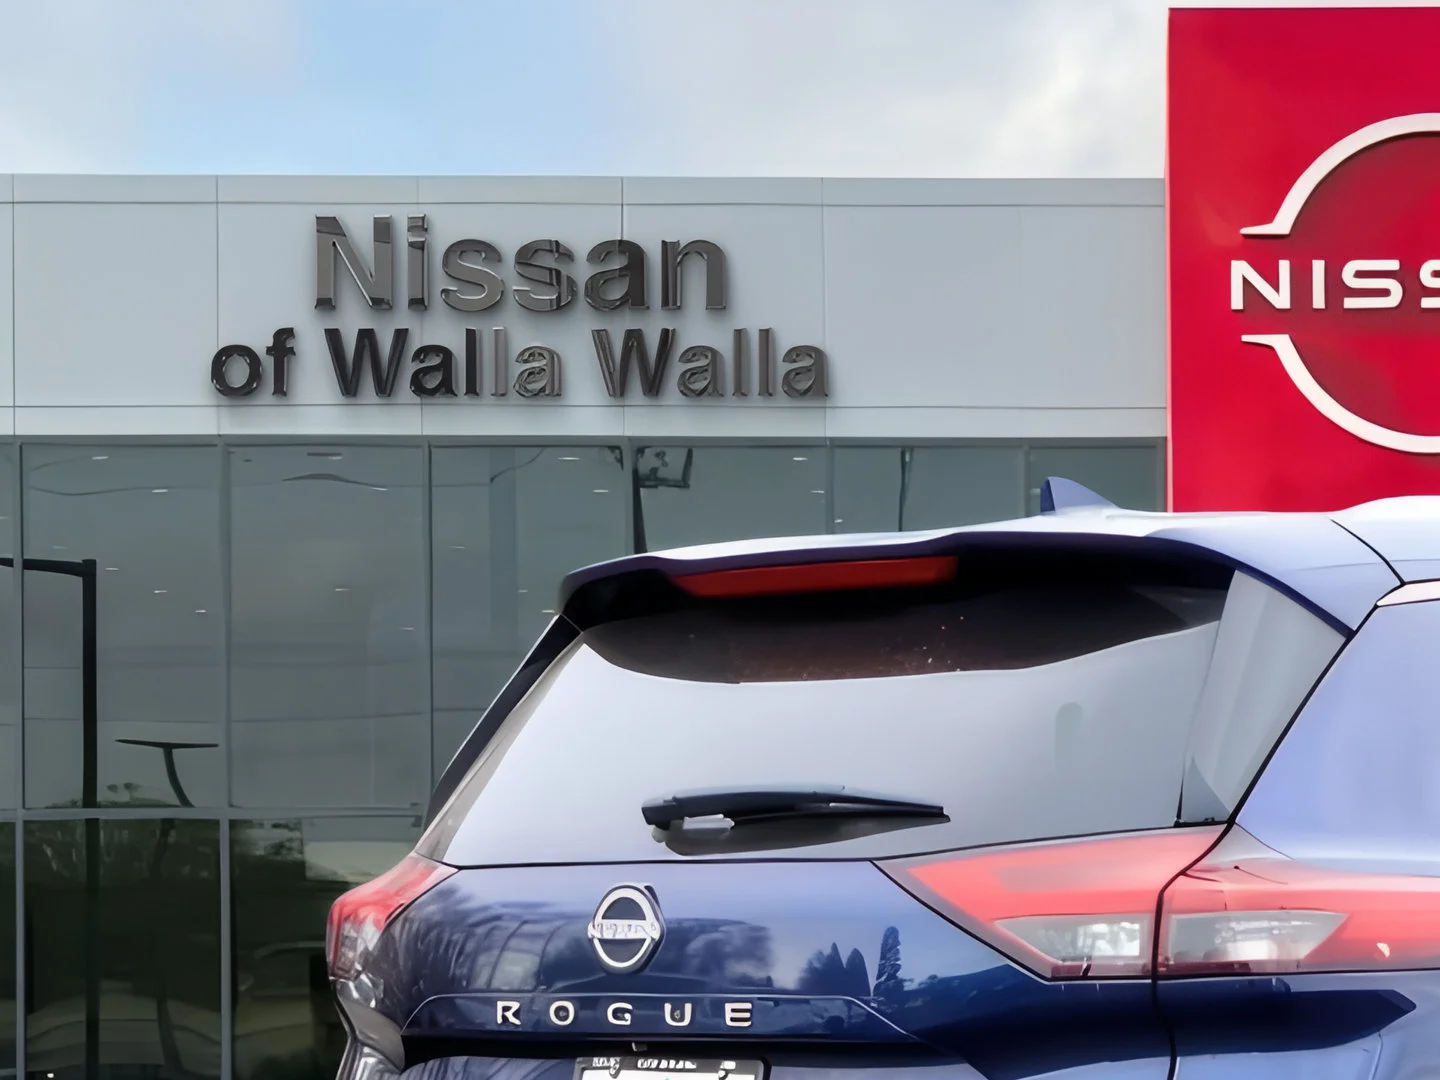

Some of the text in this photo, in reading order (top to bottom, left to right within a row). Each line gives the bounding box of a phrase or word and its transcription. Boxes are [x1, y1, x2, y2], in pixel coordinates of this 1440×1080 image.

[314, 213, 728, 312] Nissan
[210, 326, 830, 399] of Walla Walla
[496, 1000, 753, 1028] ROGUE
